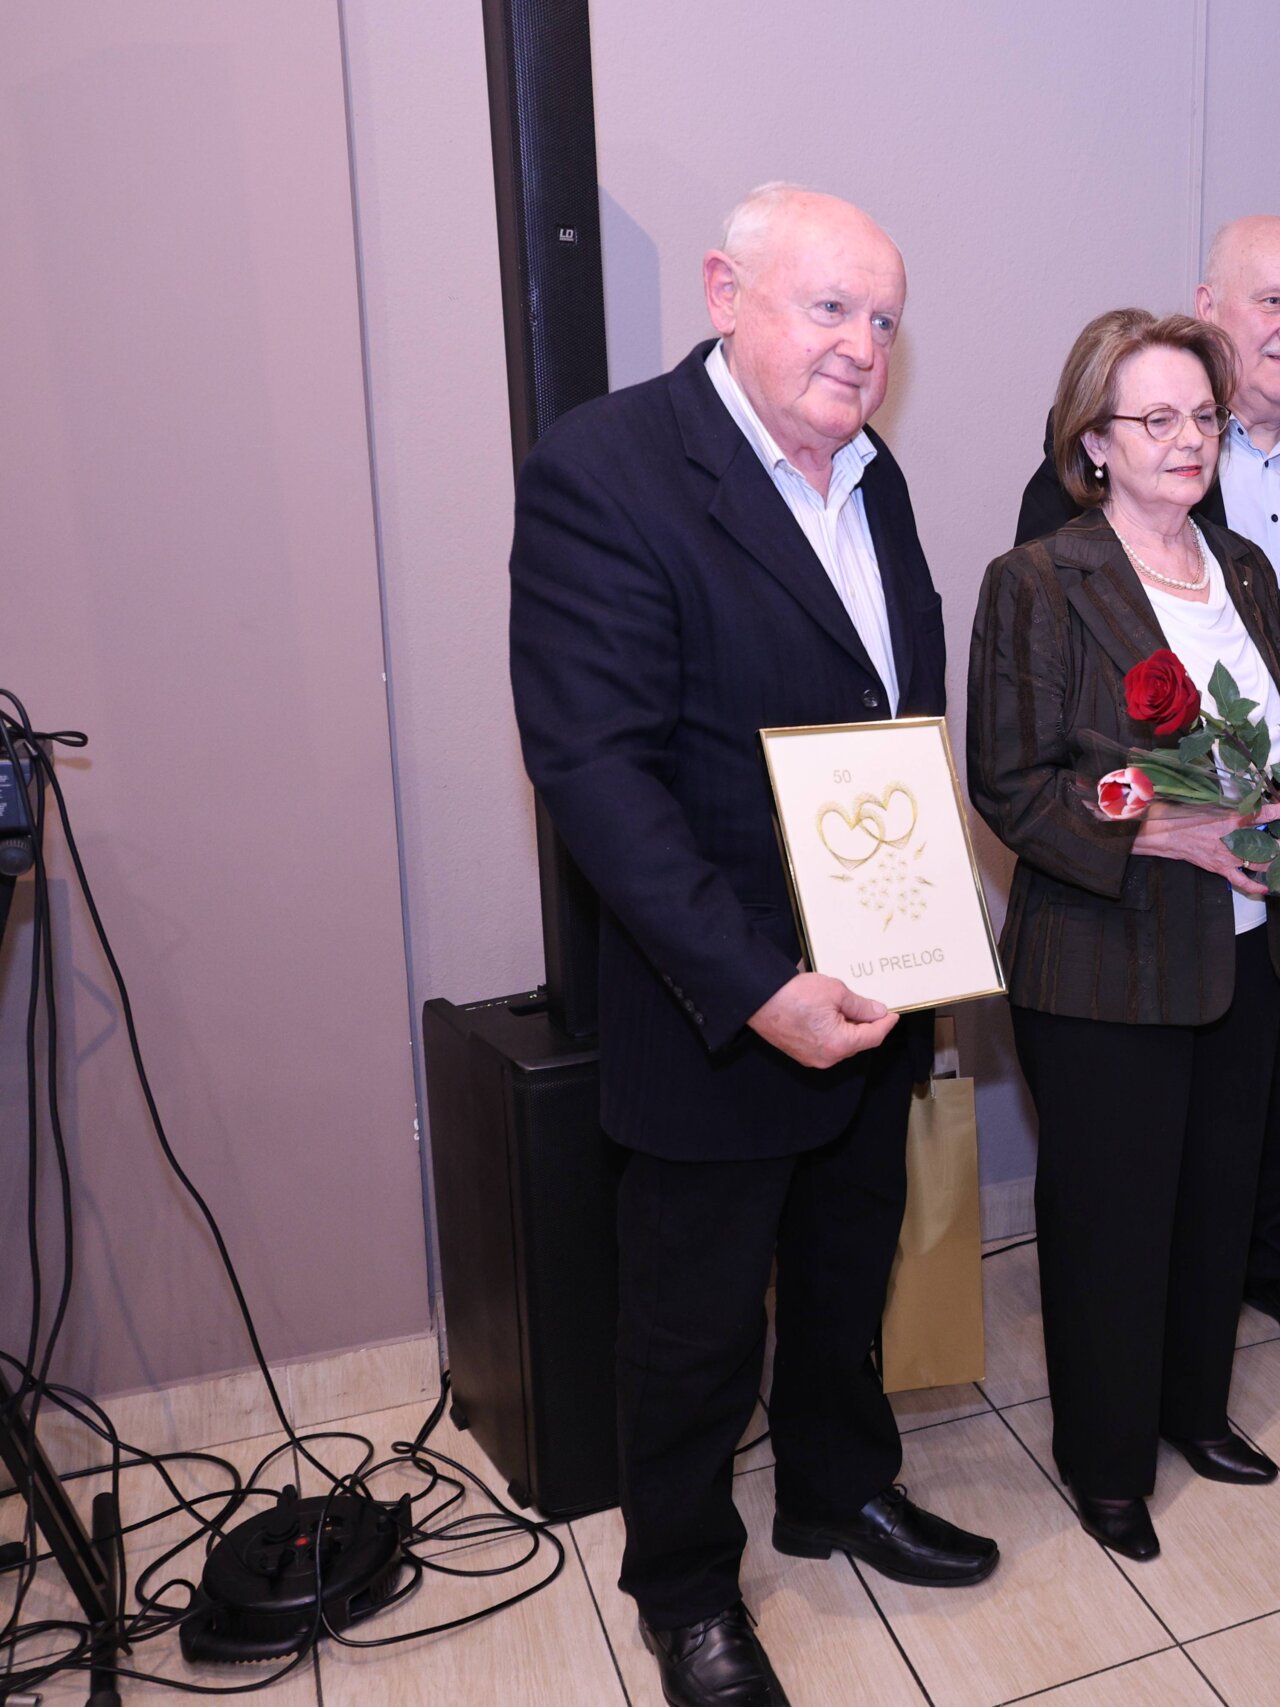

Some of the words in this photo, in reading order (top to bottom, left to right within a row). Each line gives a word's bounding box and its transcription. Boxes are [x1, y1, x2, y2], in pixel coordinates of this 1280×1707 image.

[560, 229, 574, 238] LD
[833, 769, 852, 784] 50
[850, 960, 874, 978] UU
[879, 947, 945, 973] PRELOG
